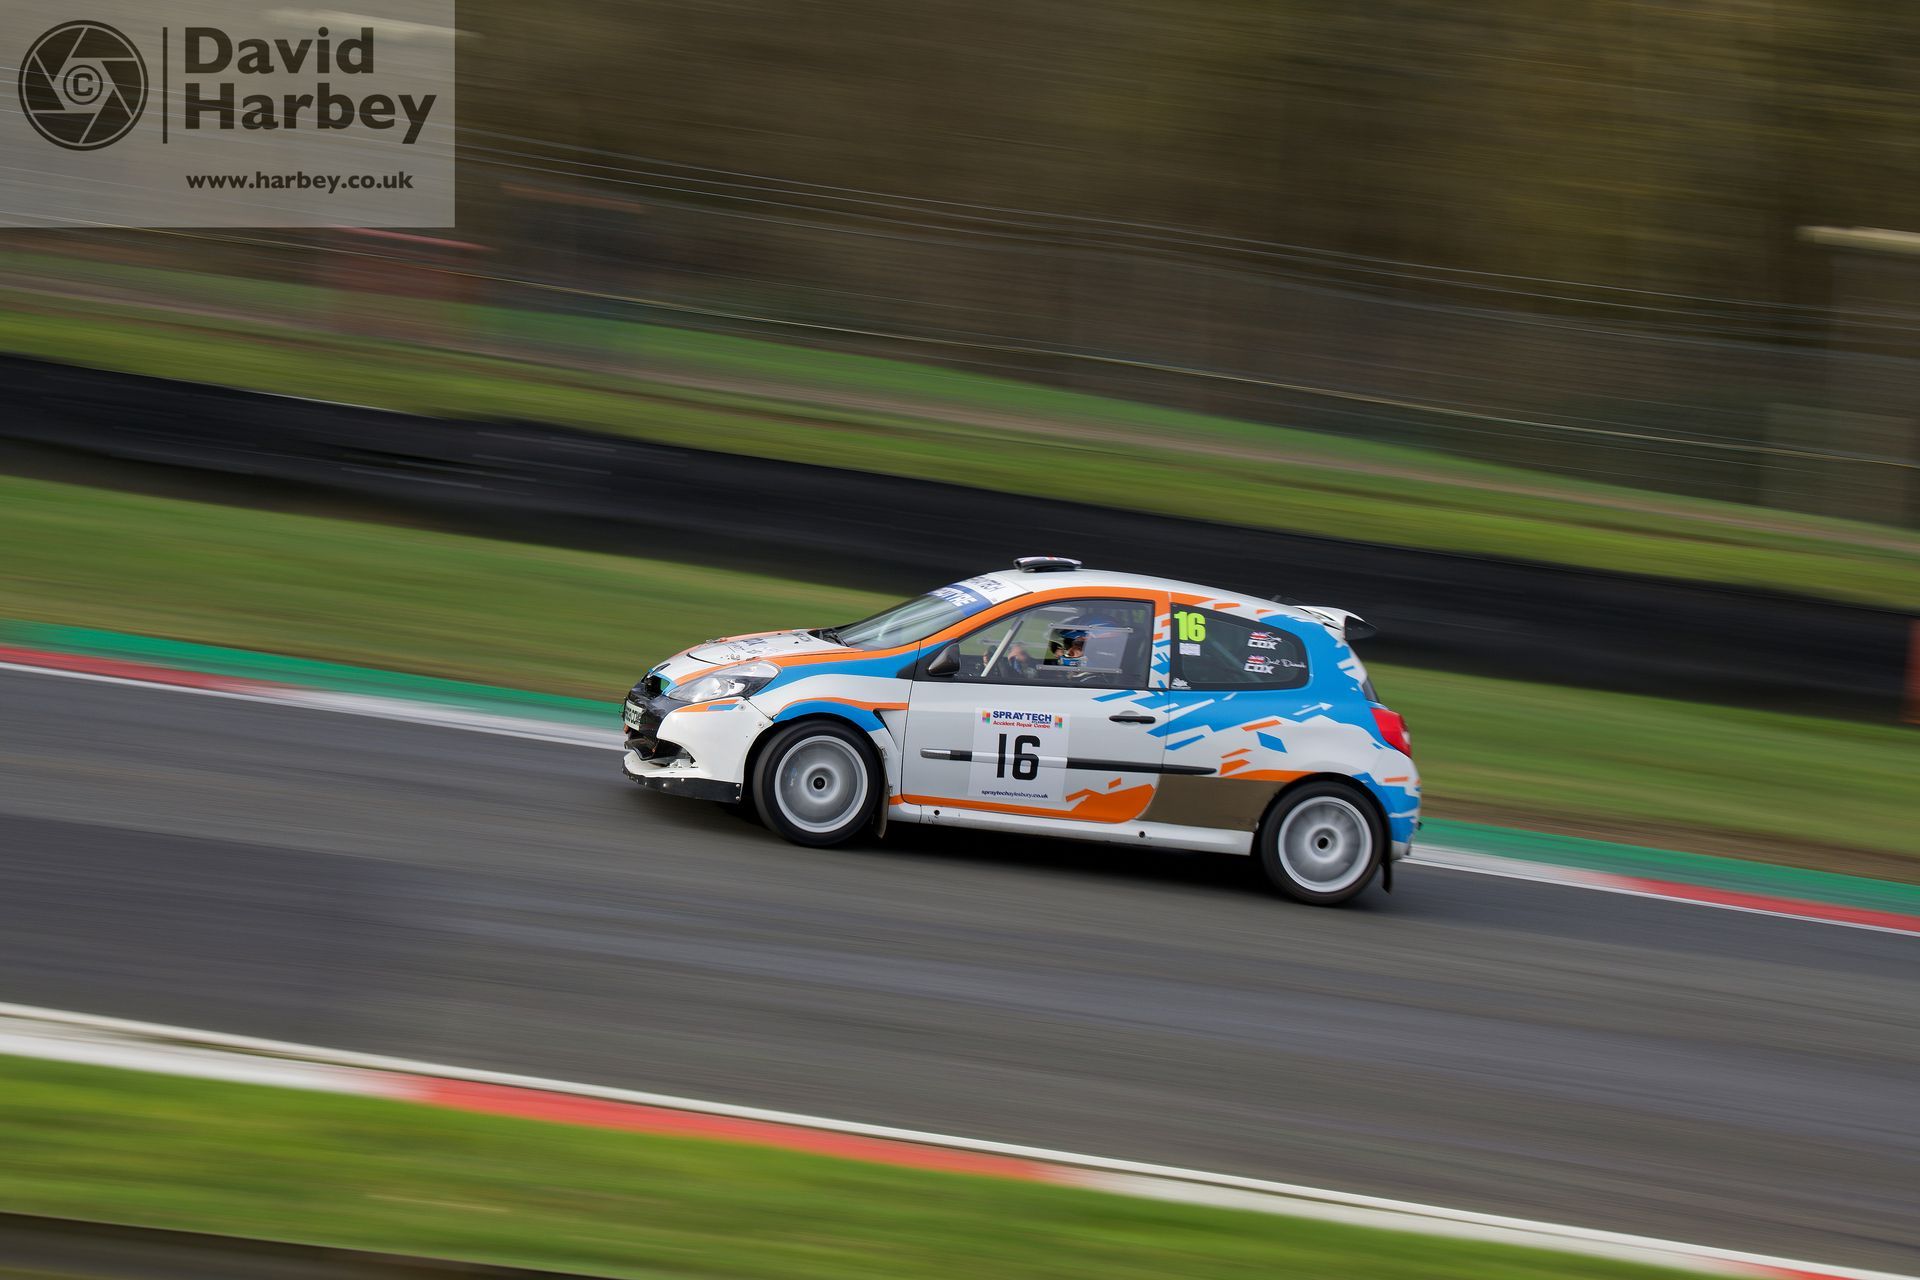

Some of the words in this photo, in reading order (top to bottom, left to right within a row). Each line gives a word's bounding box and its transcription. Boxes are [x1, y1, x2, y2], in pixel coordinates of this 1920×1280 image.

[1174, 611, 1206, 642] 16
[1247, 639, 1278, 650] COX
[1243, 663, 1275, 675] COX
[993, 711, 1052, 722] SPRAYTECH
[997, 733, 1040, 780] 16
